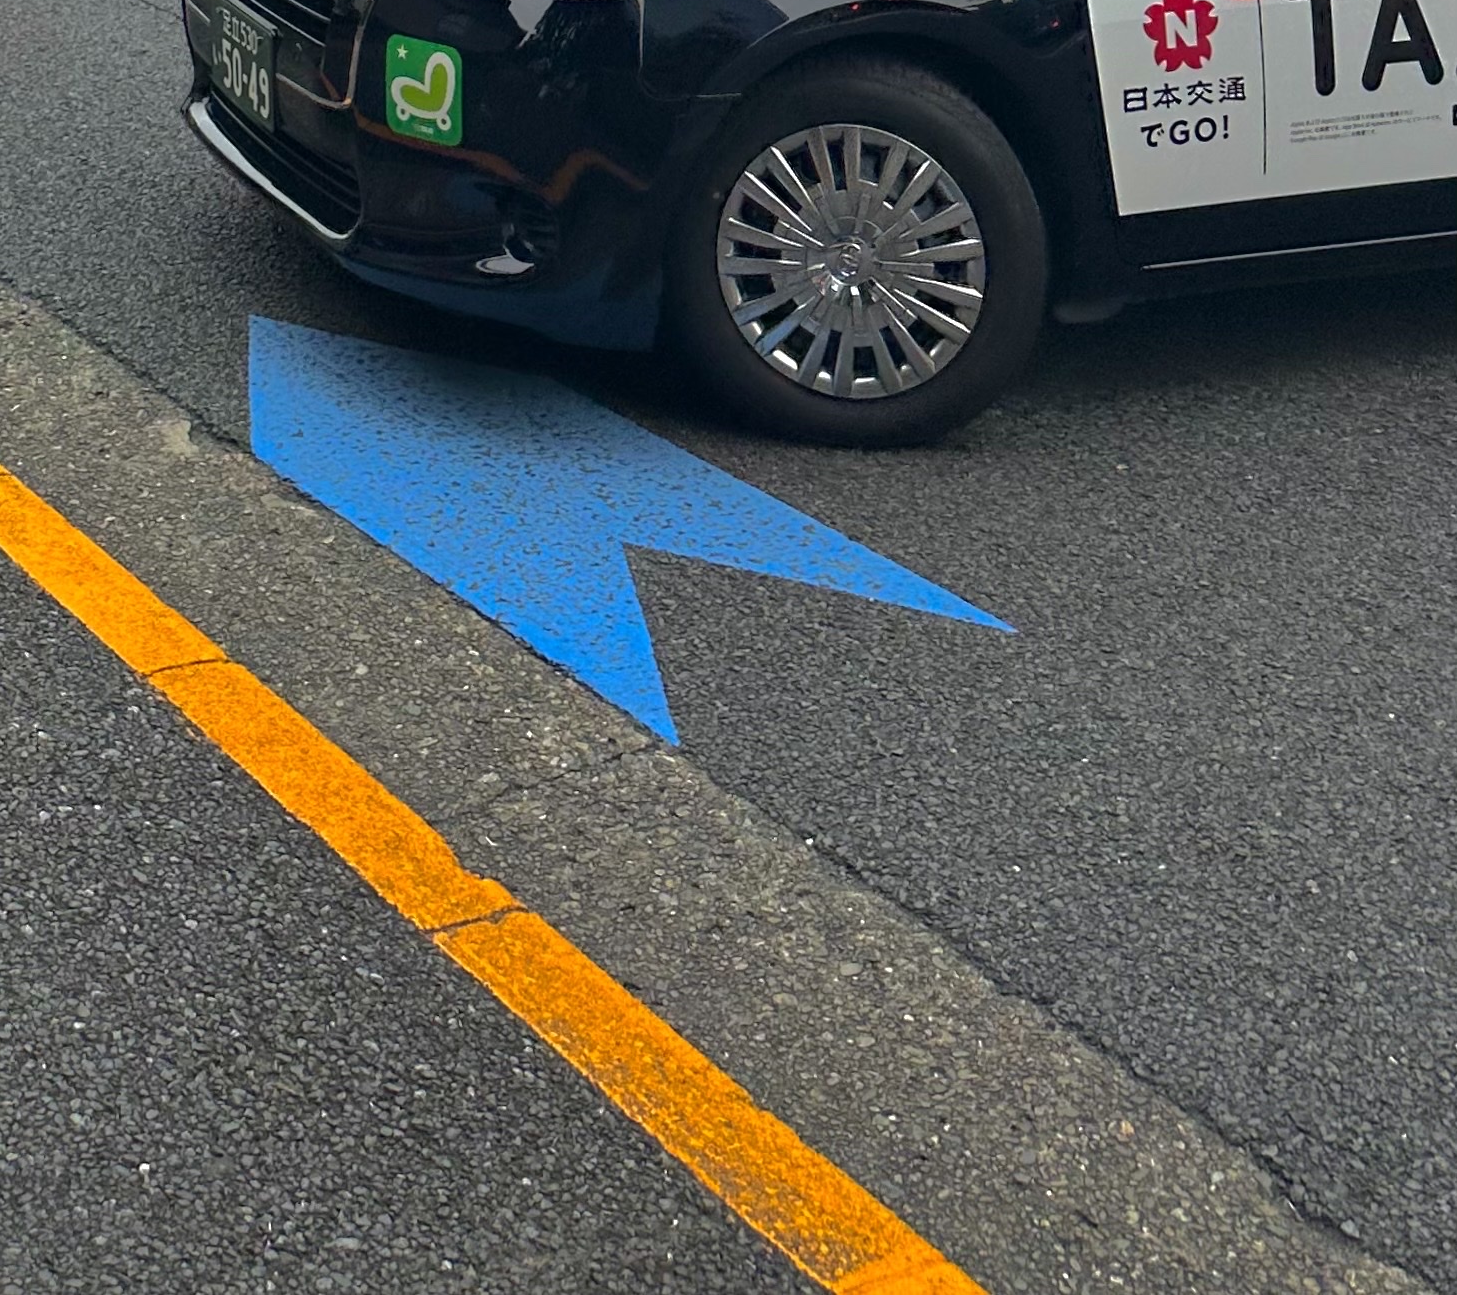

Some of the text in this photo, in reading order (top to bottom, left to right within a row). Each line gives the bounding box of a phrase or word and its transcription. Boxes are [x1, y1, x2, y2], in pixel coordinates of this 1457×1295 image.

[1163, 9, 1199, 50] N
[222, 38, 270, 119] 50-49
[1123, 76, 1247, 113] 日本交通
[1141, 114, 1230, 148] でGO!
